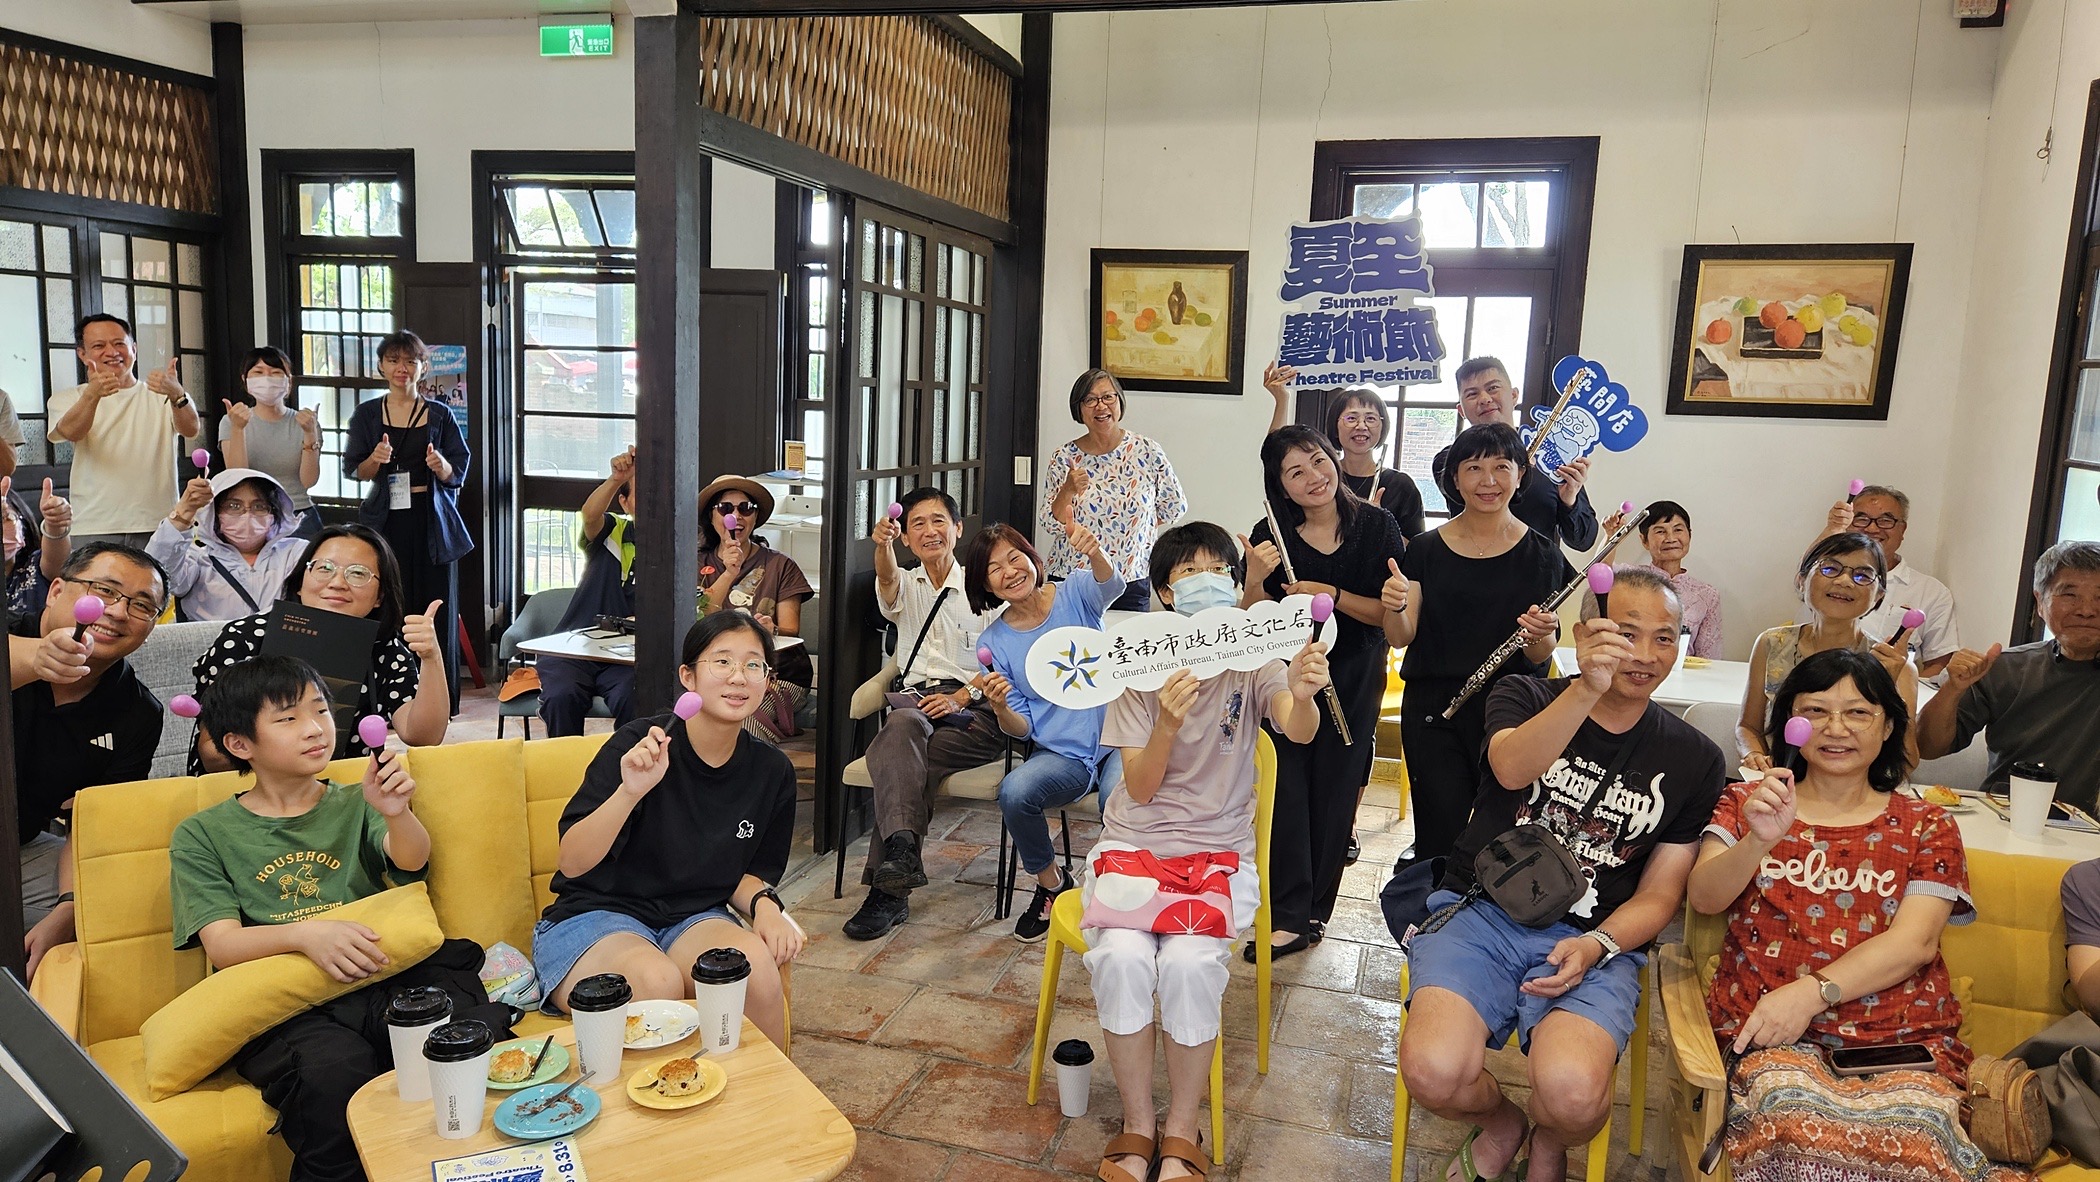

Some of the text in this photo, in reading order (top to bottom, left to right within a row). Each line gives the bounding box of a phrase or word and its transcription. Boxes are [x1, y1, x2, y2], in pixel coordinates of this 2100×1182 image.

[1281, 218, 1430, 301] 夏至
[1319, 296, 1398, 309] Summer
[1278, 308, 1444, 367] 藝術節
[1286, 365, 1438, 386] heatre Festival
[1107, 608, 1313, 665] 臺南市政府文化局
[1112, 636, 1308, 680] Cultural Affairs Bureau, Tainan City Governm
[1574, 756, 1588, 769] An
[1592, 806, 1625, 825] Heart
